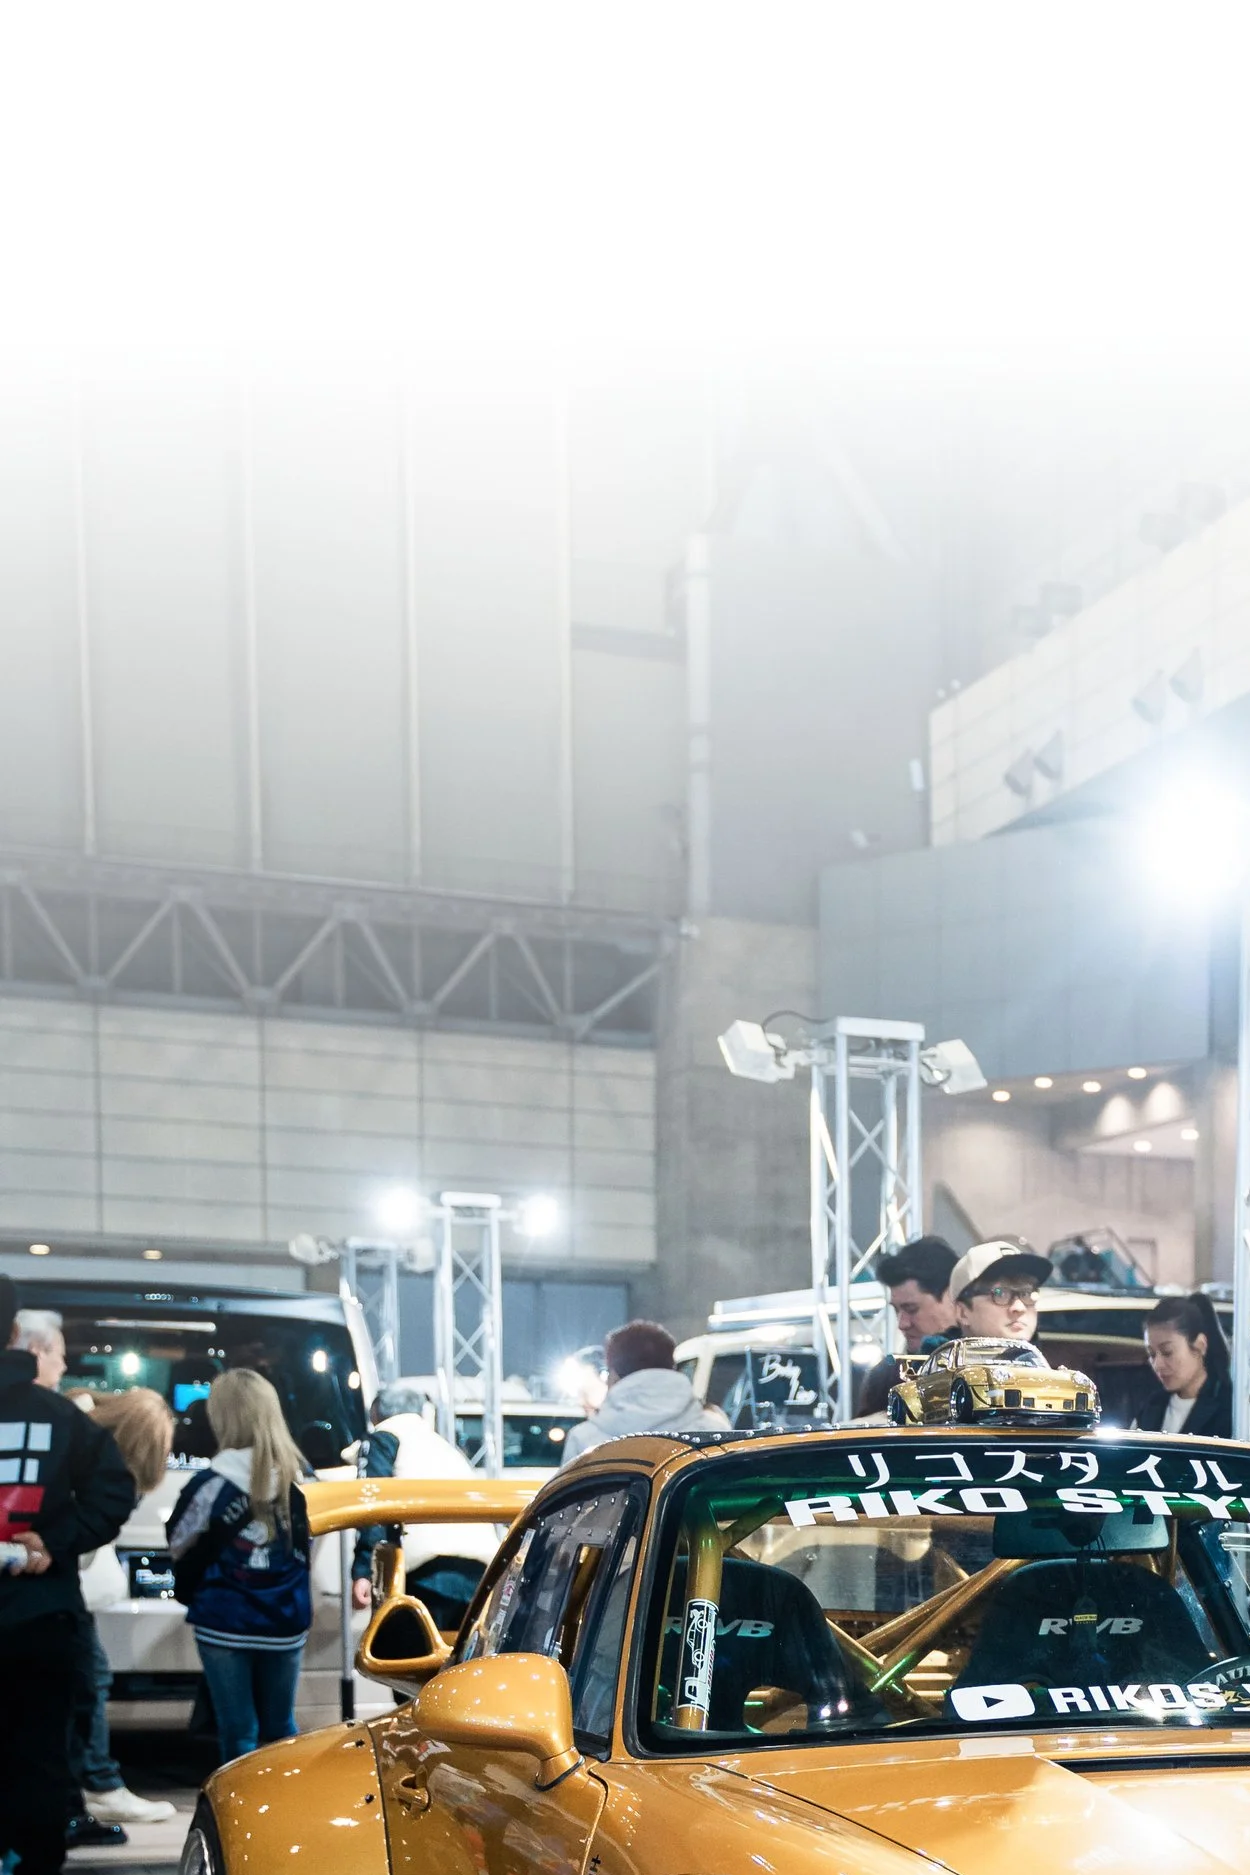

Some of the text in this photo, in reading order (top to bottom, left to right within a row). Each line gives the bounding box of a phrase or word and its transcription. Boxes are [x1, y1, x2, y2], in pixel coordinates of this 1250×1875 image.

[848, 1451, 1242, 1491] リコスタイル
[785, 1487, 1027, 1527] RIKO
